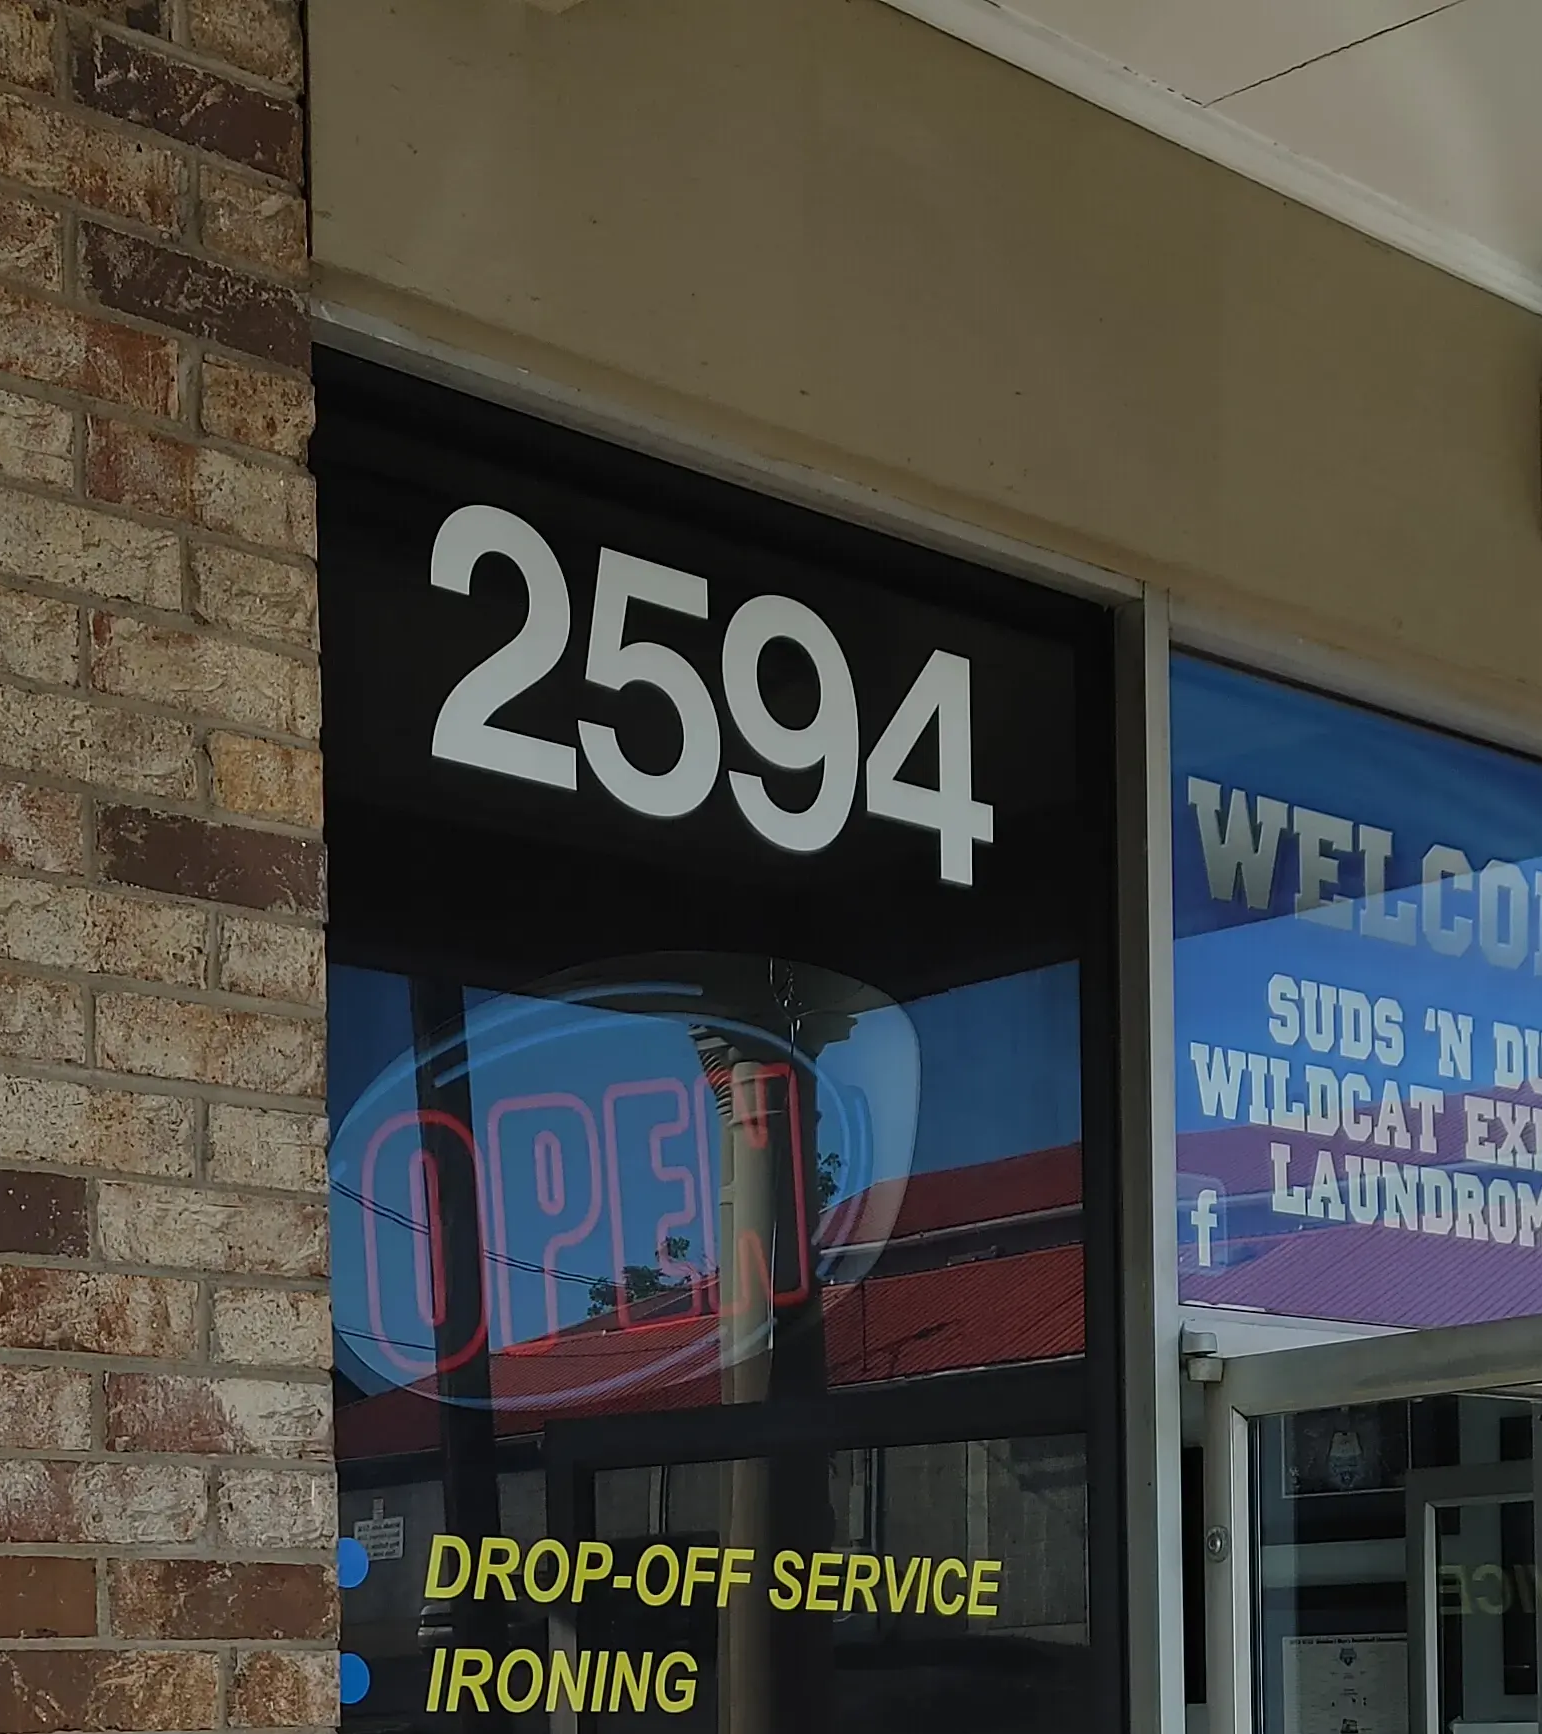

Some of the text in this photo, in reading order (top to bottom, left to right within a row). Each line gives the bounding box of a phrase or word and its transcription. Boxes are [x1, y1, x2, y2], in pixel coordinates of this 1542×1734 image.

[430, 504, 993, 886] 2594
[1268, 973, 1404, 1066] SUDS
[1190, 1043, 1444, 1155] WILDCAT
[361, 1061, 809, 1374] OPEN
[424, 1534, 755, 1608] DROP-OFF
[768, 1550, 1002, 1617] SERVICE
[425, 1647, 698, 1714] IRONING
